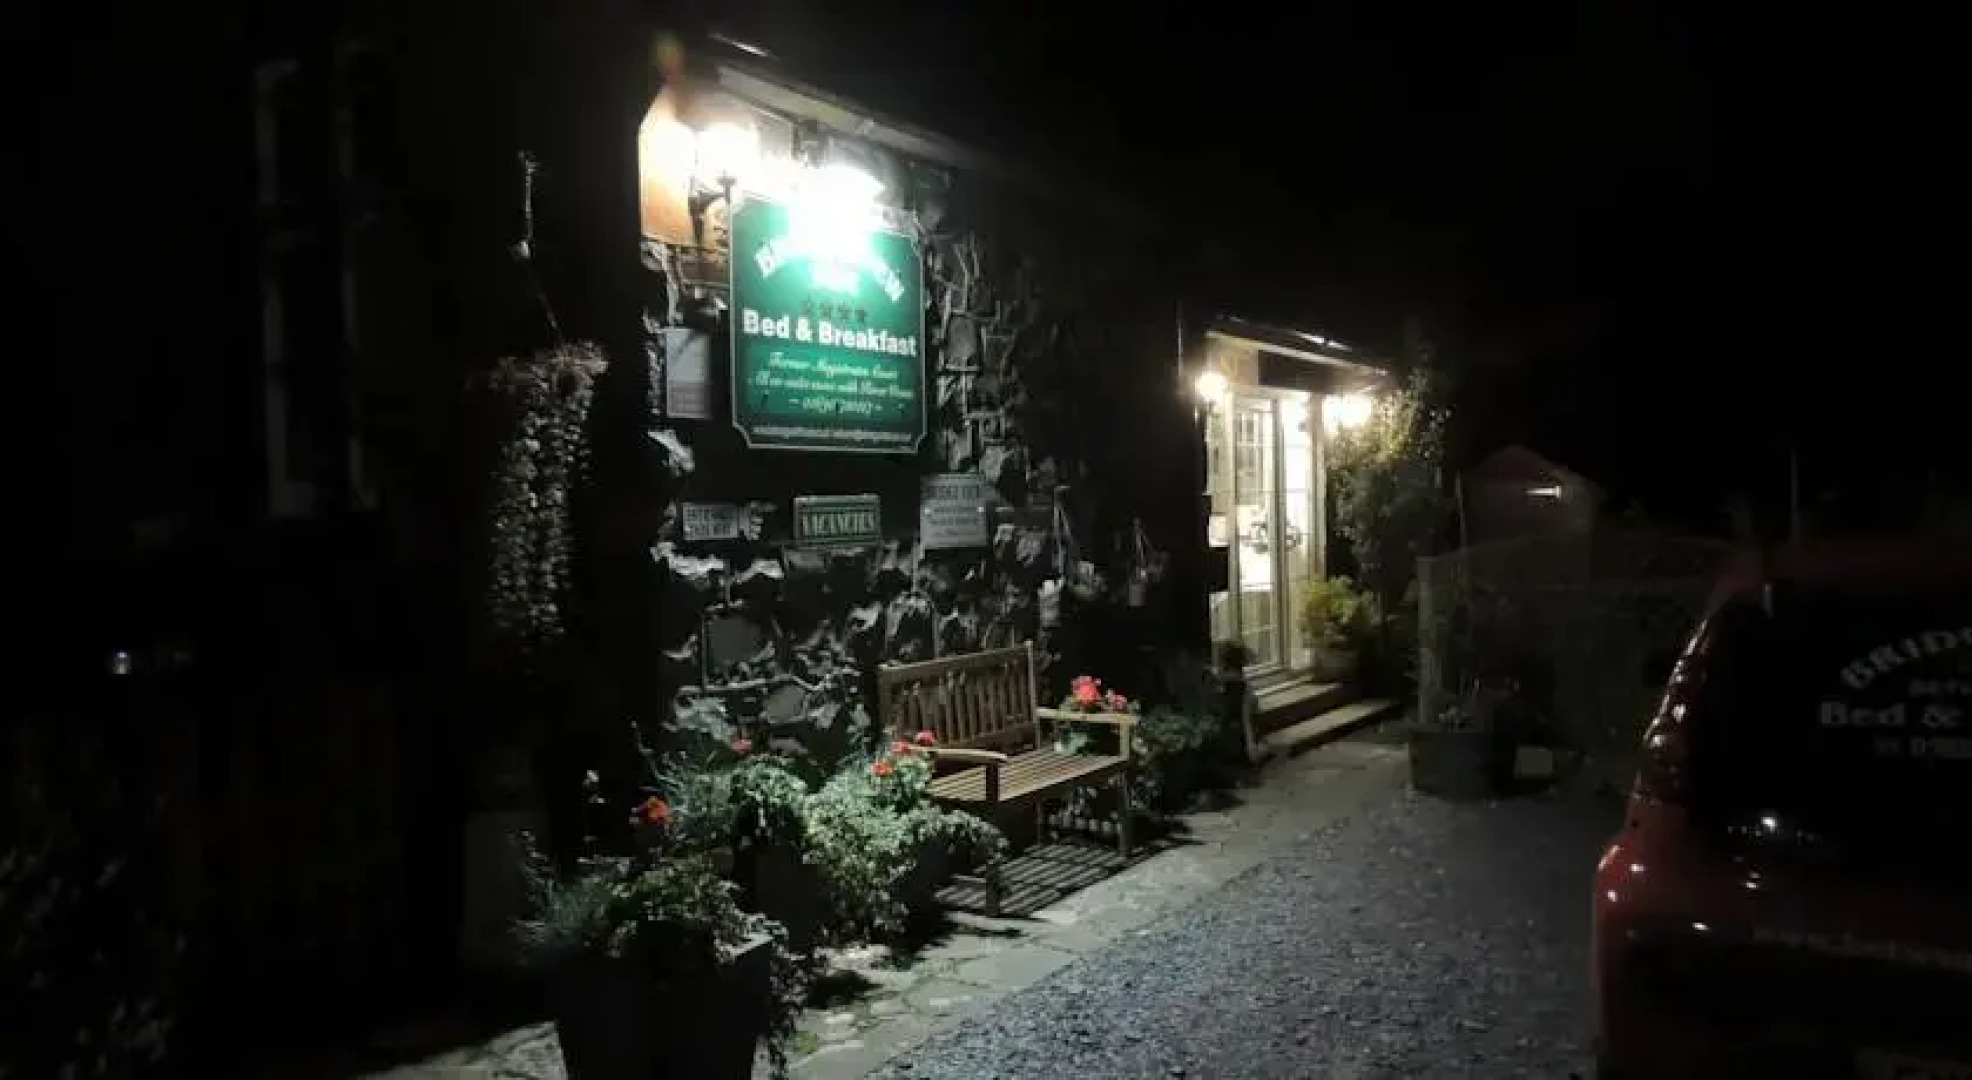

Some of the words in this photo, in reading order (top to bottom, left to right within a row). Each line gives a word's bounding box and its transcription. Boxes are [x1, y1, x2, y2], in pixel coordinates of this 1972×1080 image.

[743, 308, 790, 339] Bed
[796, 317, 813, 342] &
[818, 320, 917, 357] Breakfast
[802, 511, 875, 537] VACANCIES
[1821, 701, 1906, 728] Bed
[1920, 702, 1963, 729] &
